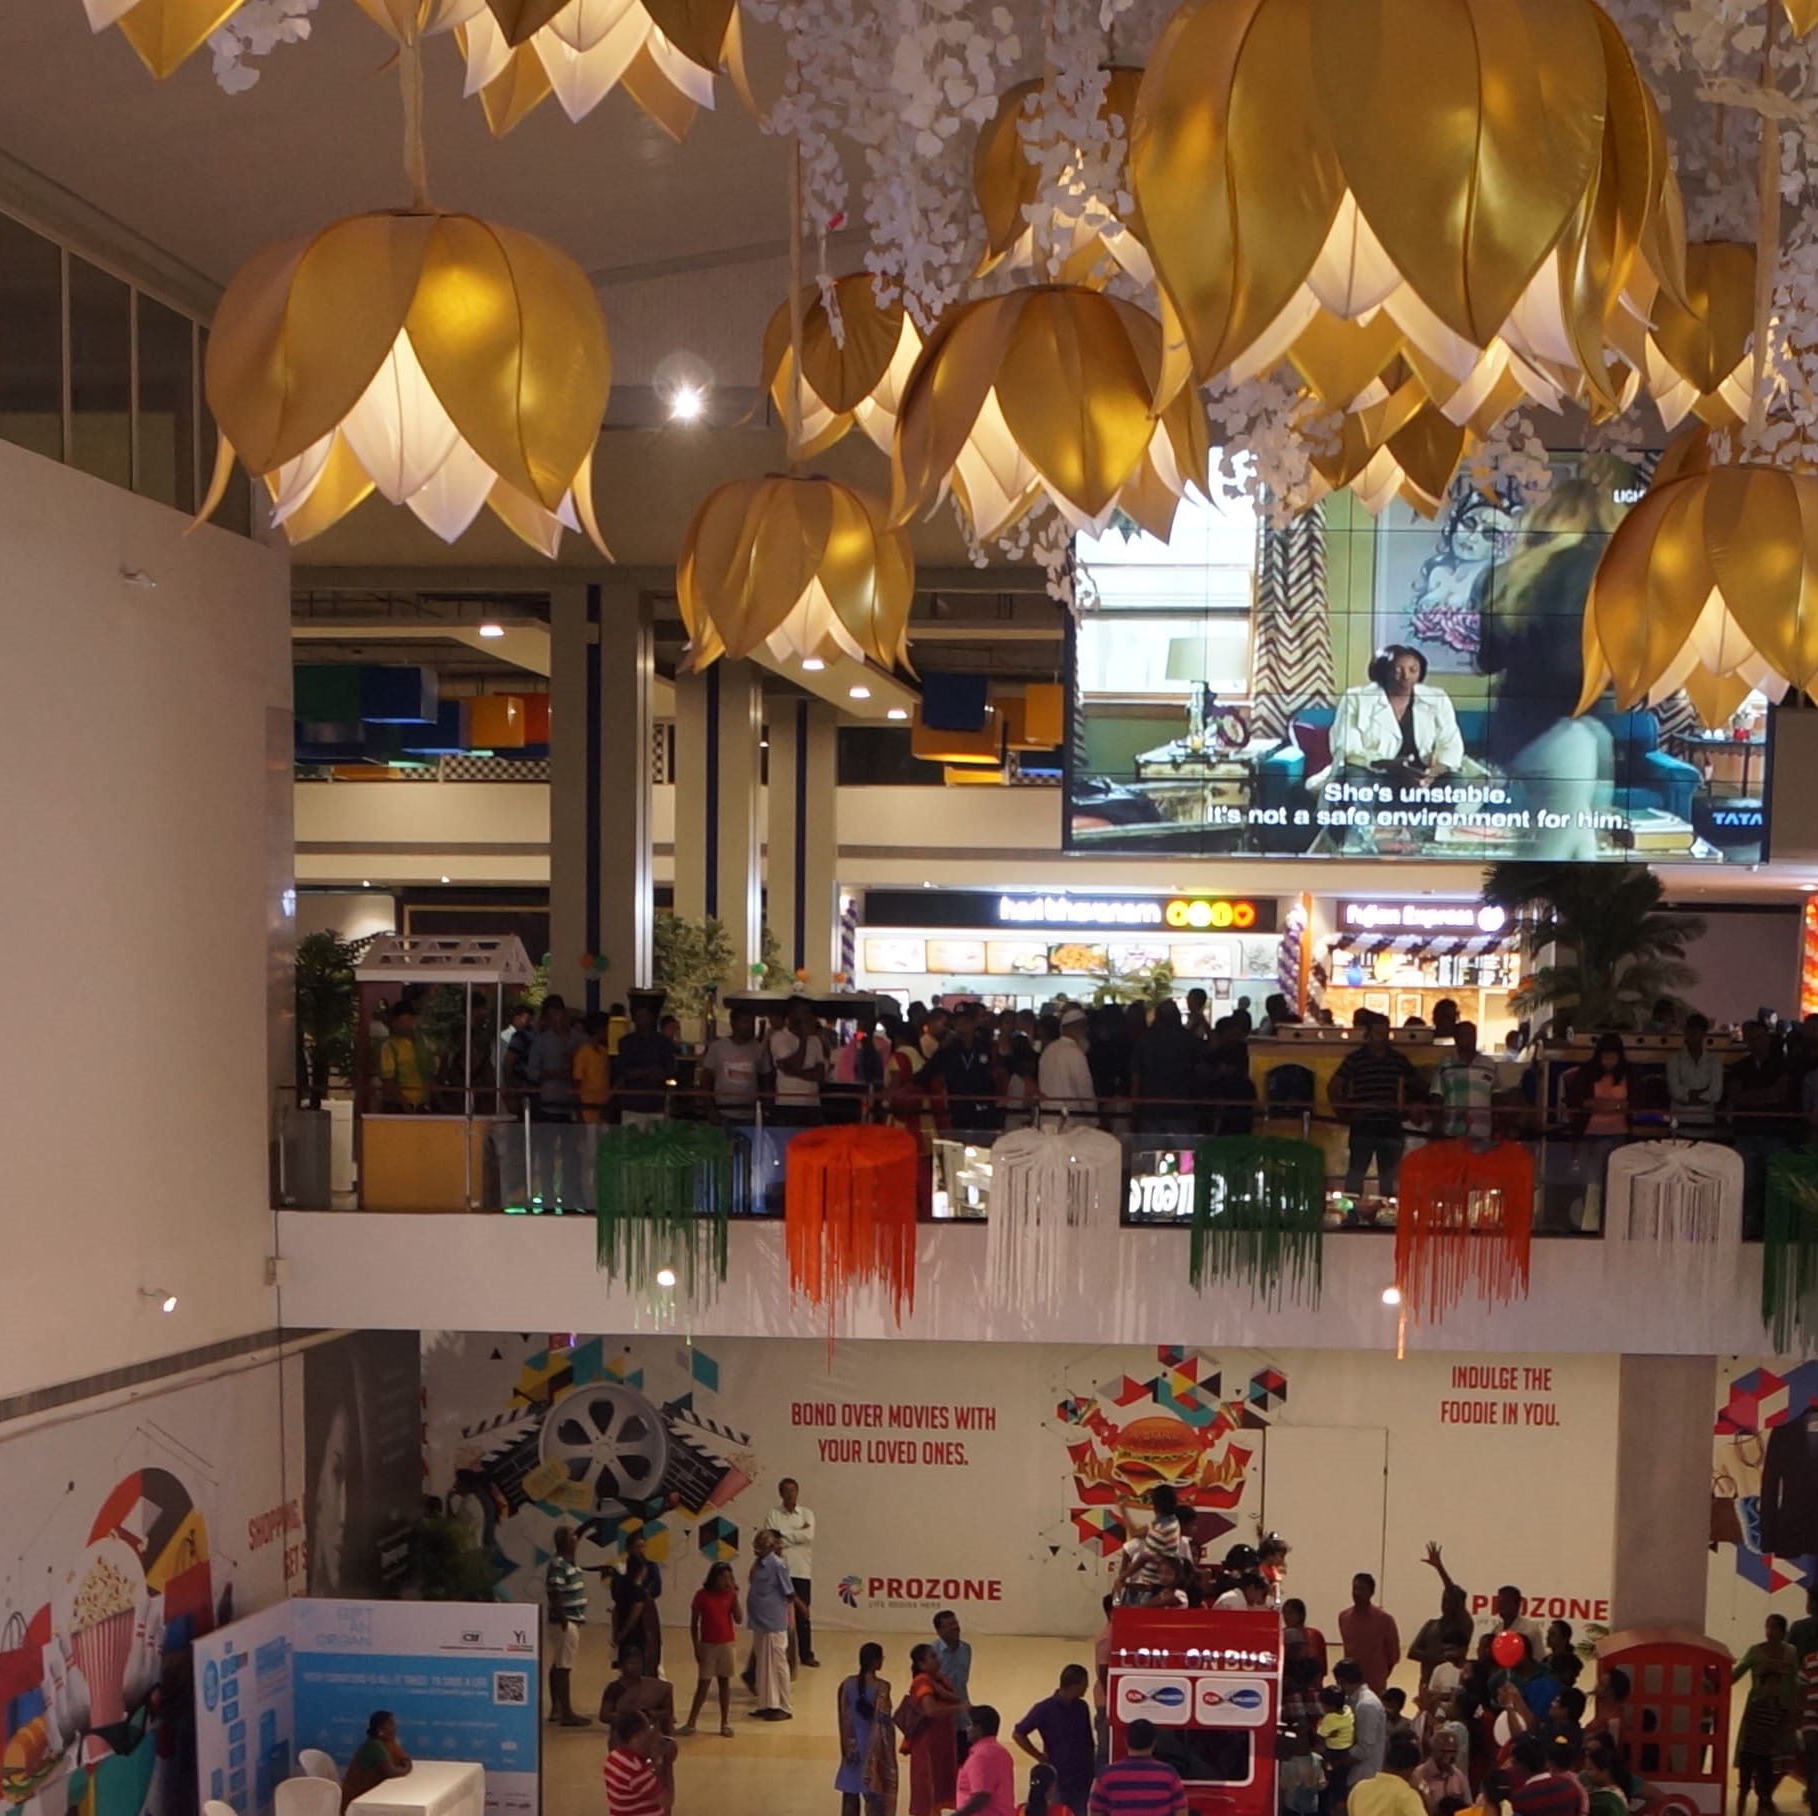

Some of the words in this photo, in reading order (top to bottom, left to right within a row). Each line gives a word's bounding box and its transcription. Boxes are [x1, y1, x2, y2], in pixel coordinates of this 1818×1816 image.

[1325, 783, 1392, 802] She's
[1400, 786, 1511, 805] unstable.
[1207, 806, 1241, 824] It's
[1248, 807, 1287, 825] not
[1294, 810, 1309, 825] a
[1317, 807, 1369, 826] safe
[1377, 808, 1530, 828] environment
[1537, 811, 1570, 829] for
[1578, 811, 1629, 831] him.
[1714, 812, 1762, 825] TATA
[1451, 1366, 1517, 1392] INDULGE
[1522, 1367, 1552, 1392] THE
[791, 1403, 835, 1429] BOND
[839, 1404, 883, 1429] OVER
[889, 1405, 949, 1431] MOVIES
[953, 1405, 996, 1431] WITH
[1440, 1400, 1497, 1425] FOODIE
[1501, 1401, 1517, 1426] IN
[1522, 1401, 1560, 1427] YOU.
[818, 1439, 862, 1464] YOUR
[868, 1439, 919, 1465] LOVED
[922, 1440, 968, 1466] ONES.
[868, 1577, 1002, 1601] PROZONE
